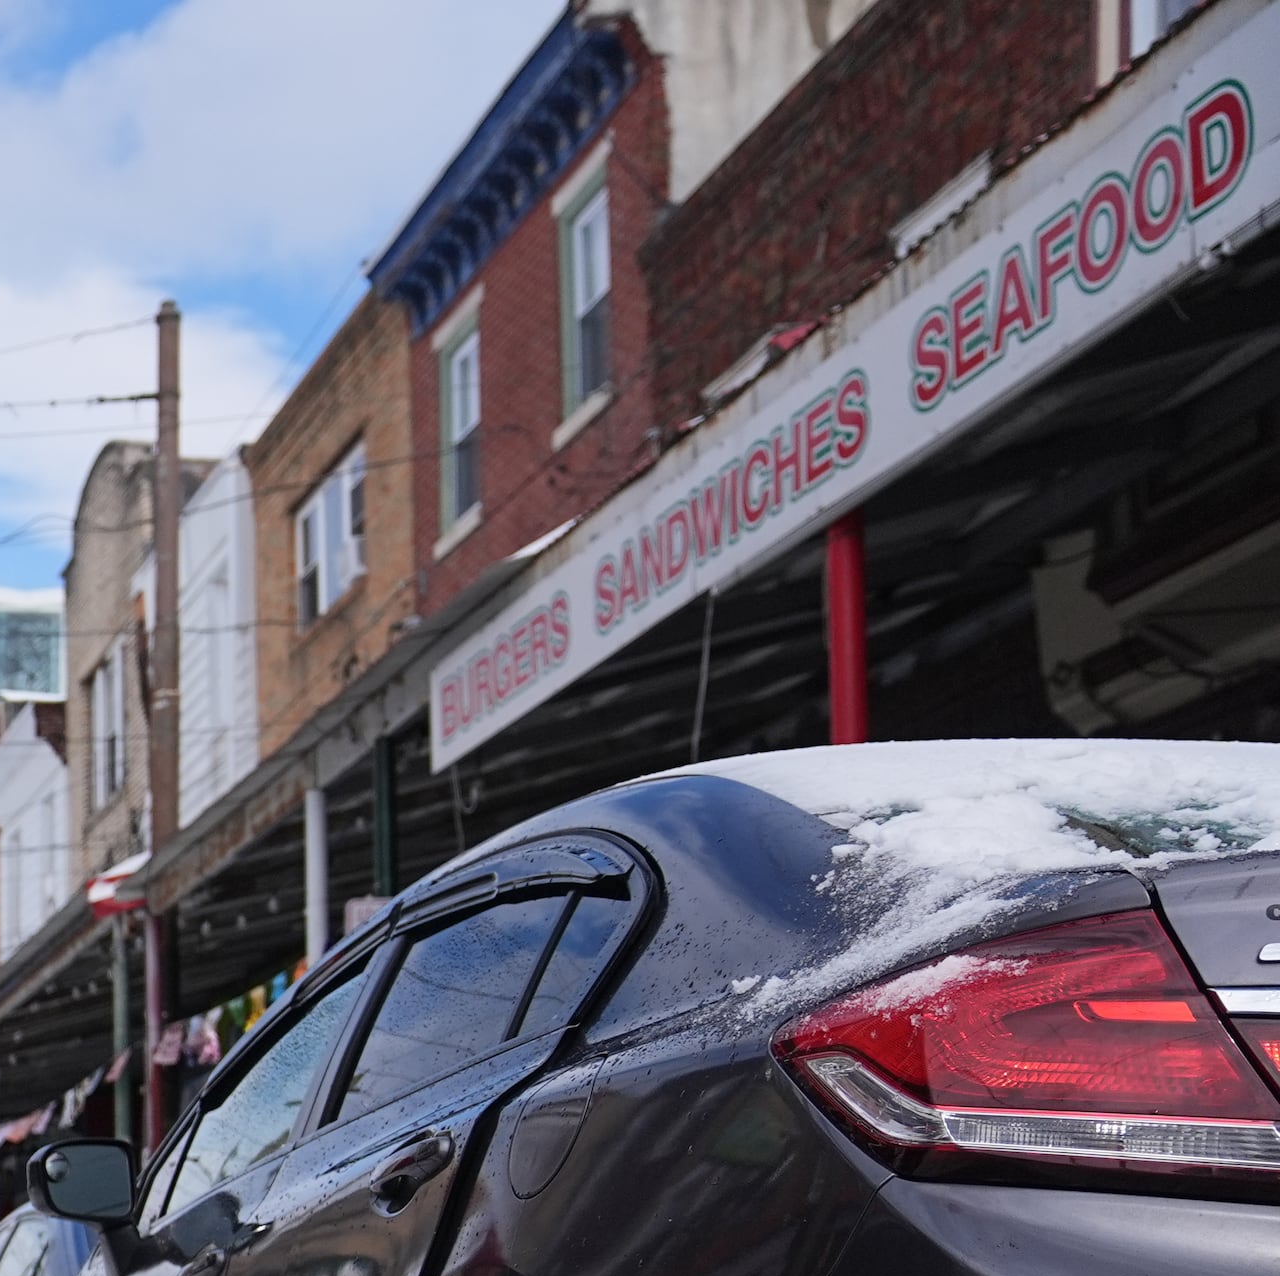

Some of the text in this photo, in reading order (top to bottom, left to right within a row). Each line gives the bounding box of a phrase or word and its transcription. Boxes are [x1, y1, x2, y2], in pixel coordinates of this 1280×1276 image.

[441, 79, 1254, 746] BURGERS SANDWICHES SEAFOOD
